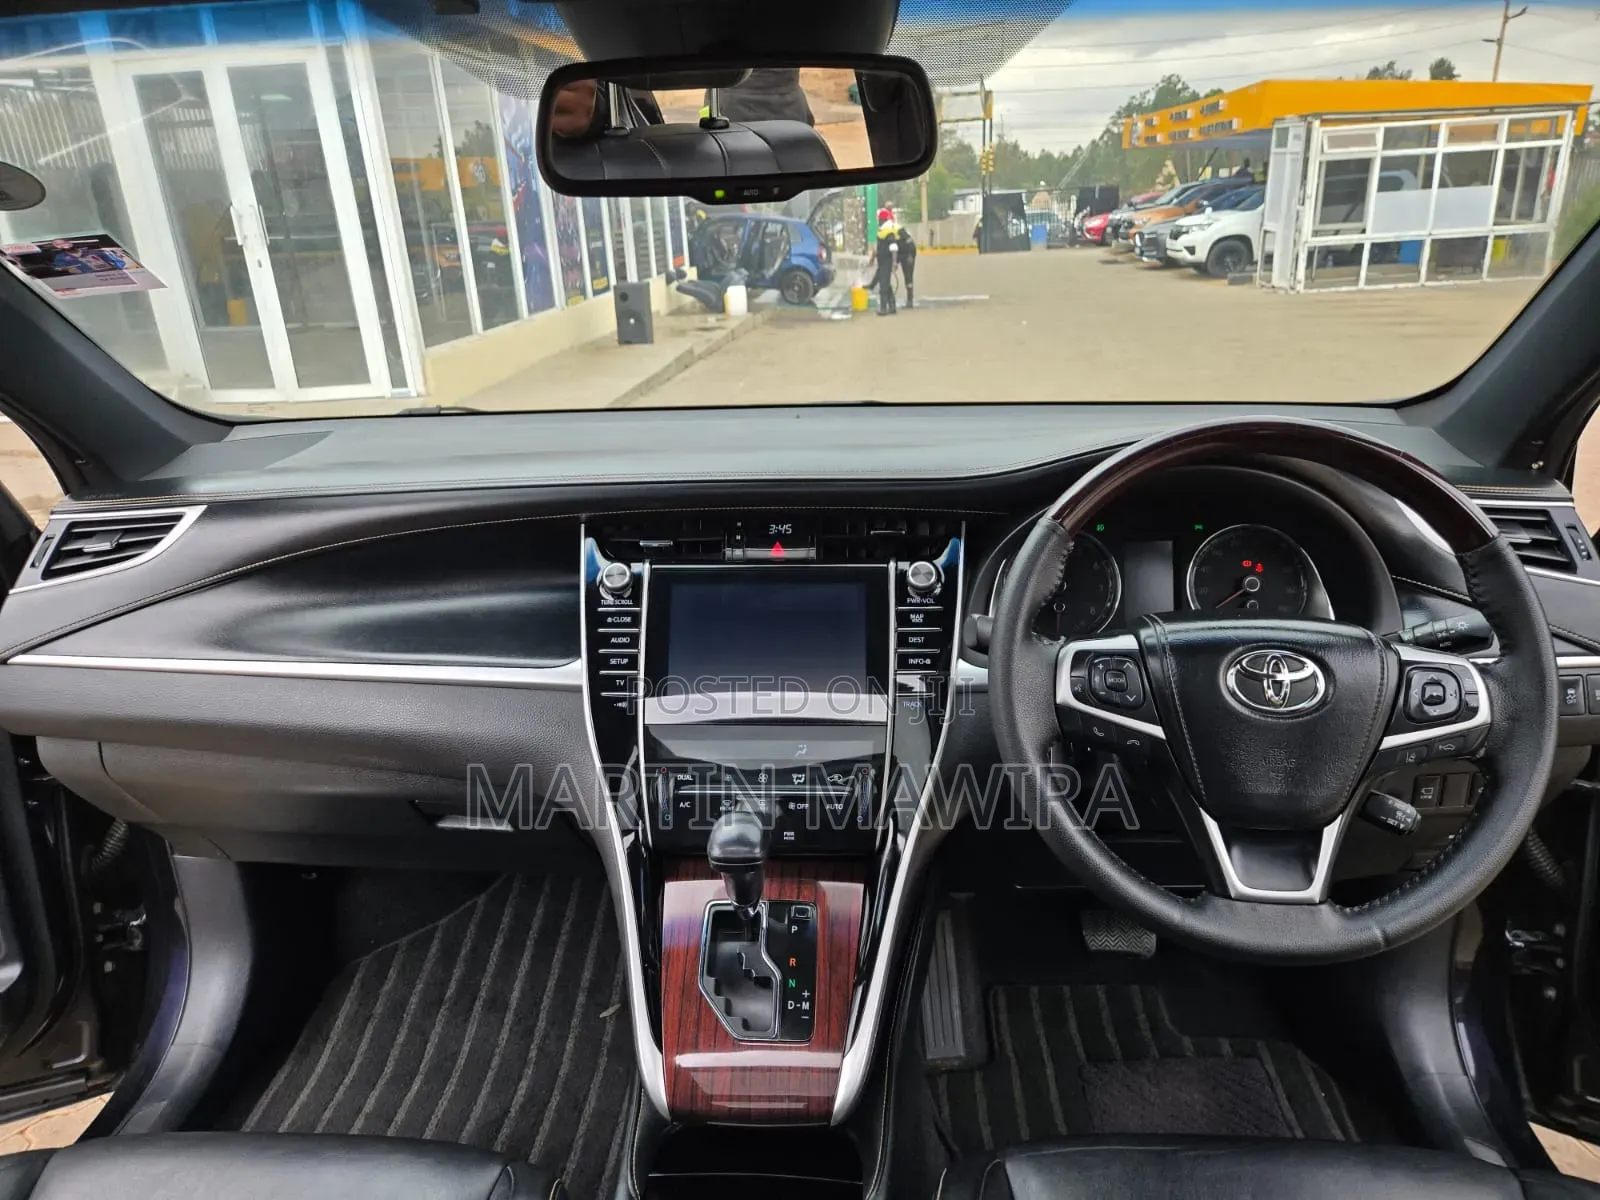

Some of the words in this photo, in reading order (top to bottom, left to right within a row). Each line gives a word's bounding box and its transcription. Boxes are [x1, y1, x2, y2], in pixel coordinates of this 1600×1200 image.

[769, 524, 792, 534] 3:45
[676, 773, 694, 781] DUAL
[679, 801, 692, 809] A/C
[791, 925, 798, 934] P
[789, 957, 797, 967] R
[788, 979, 796, 987] N
